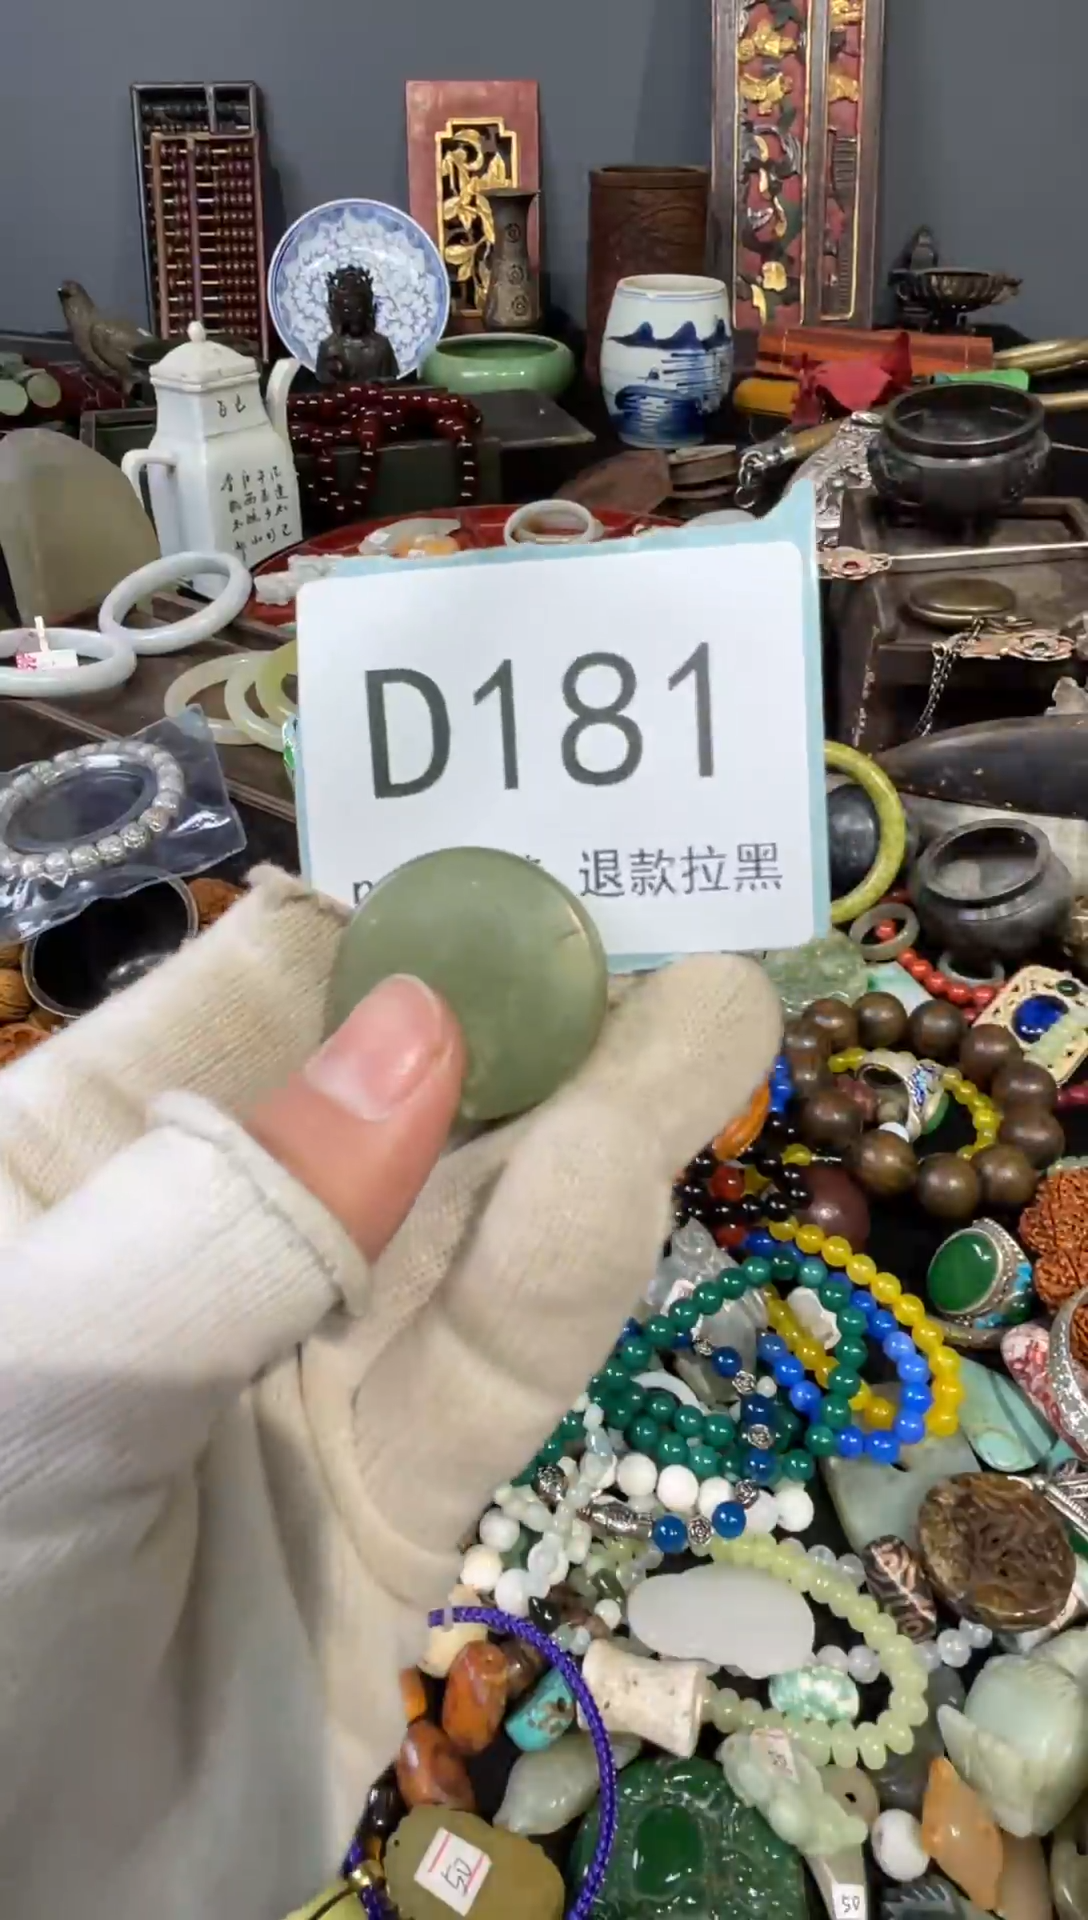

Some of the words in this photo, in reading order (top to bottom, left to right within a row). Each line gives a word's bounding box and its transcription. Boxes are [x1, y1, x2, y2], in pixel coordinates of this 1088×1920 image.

[366, 642, 714, 799] D181
[579, 842, 783, 898] 退款拉黑
